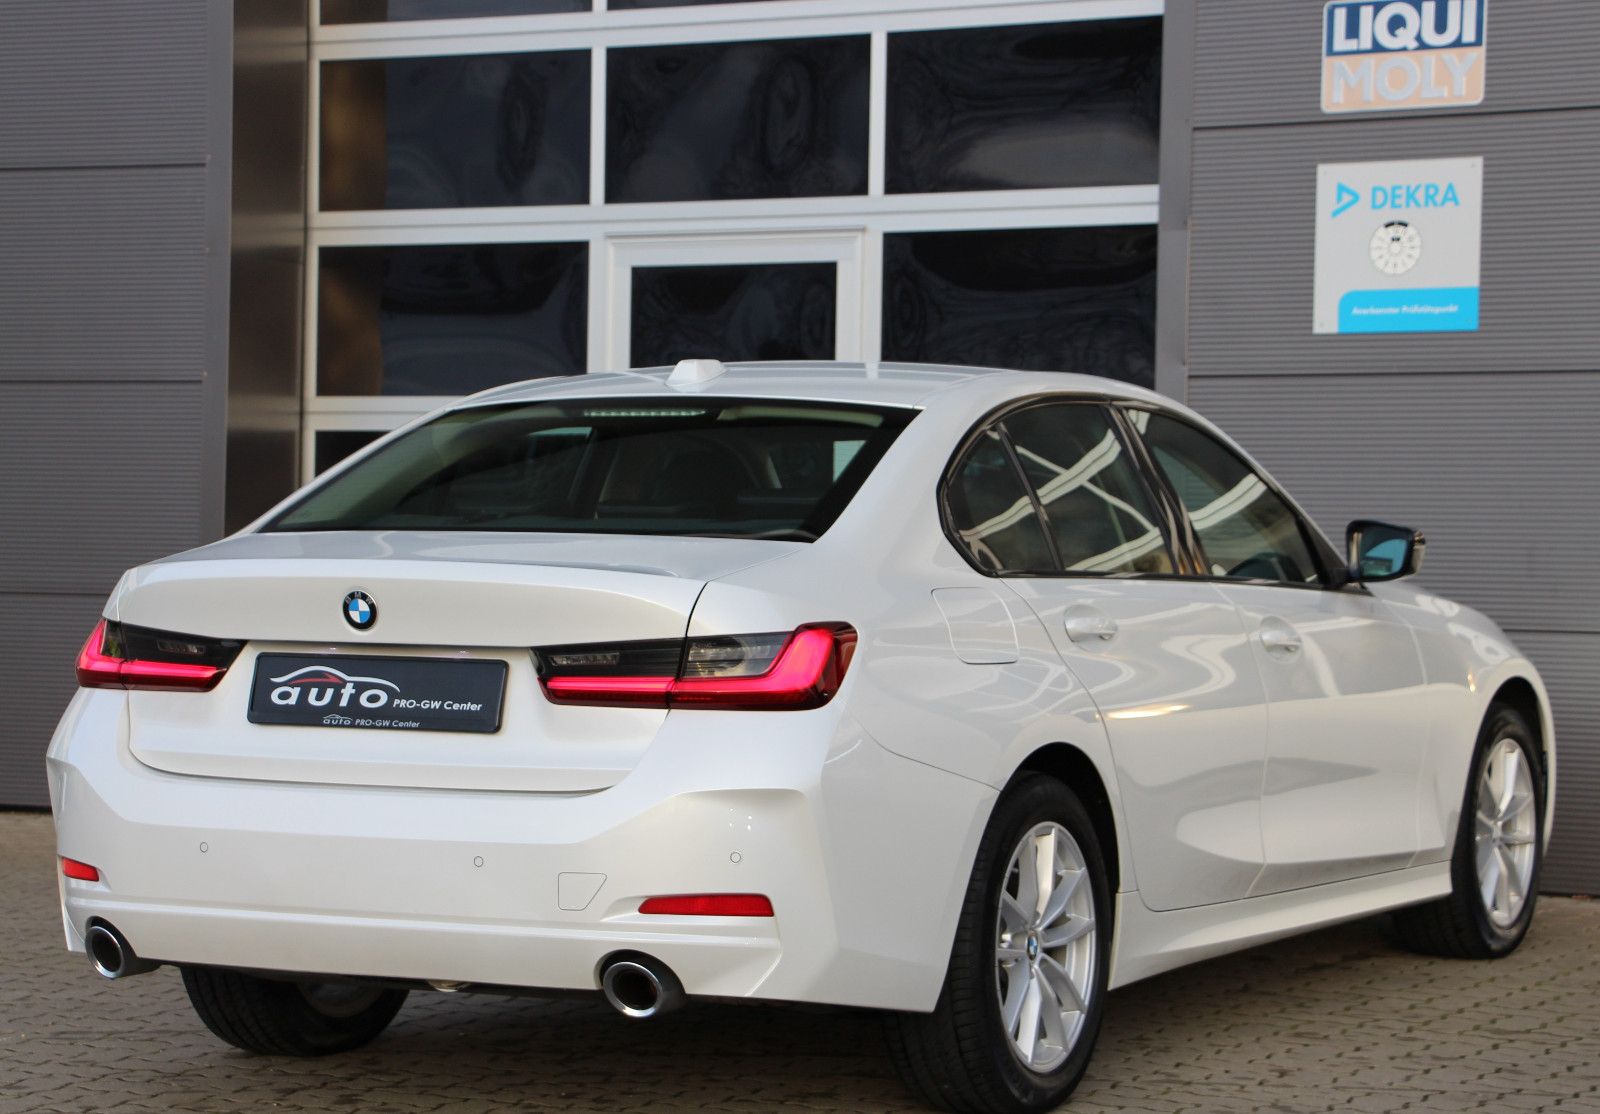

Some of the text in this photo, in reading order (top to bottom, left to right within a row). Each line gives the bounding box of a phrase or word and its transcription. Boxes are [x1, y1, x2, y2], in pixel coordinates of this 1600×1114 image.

[1332, 0, 1477, 51] LIQUI
[1331, 53, 1478, 104] MOLY
[1371, 182, 1461, 210] DEKRA
[270, 682, 483, 712] auto PRO-GW Center
[322, 717, 421, 728] auto PRO-GW Center
